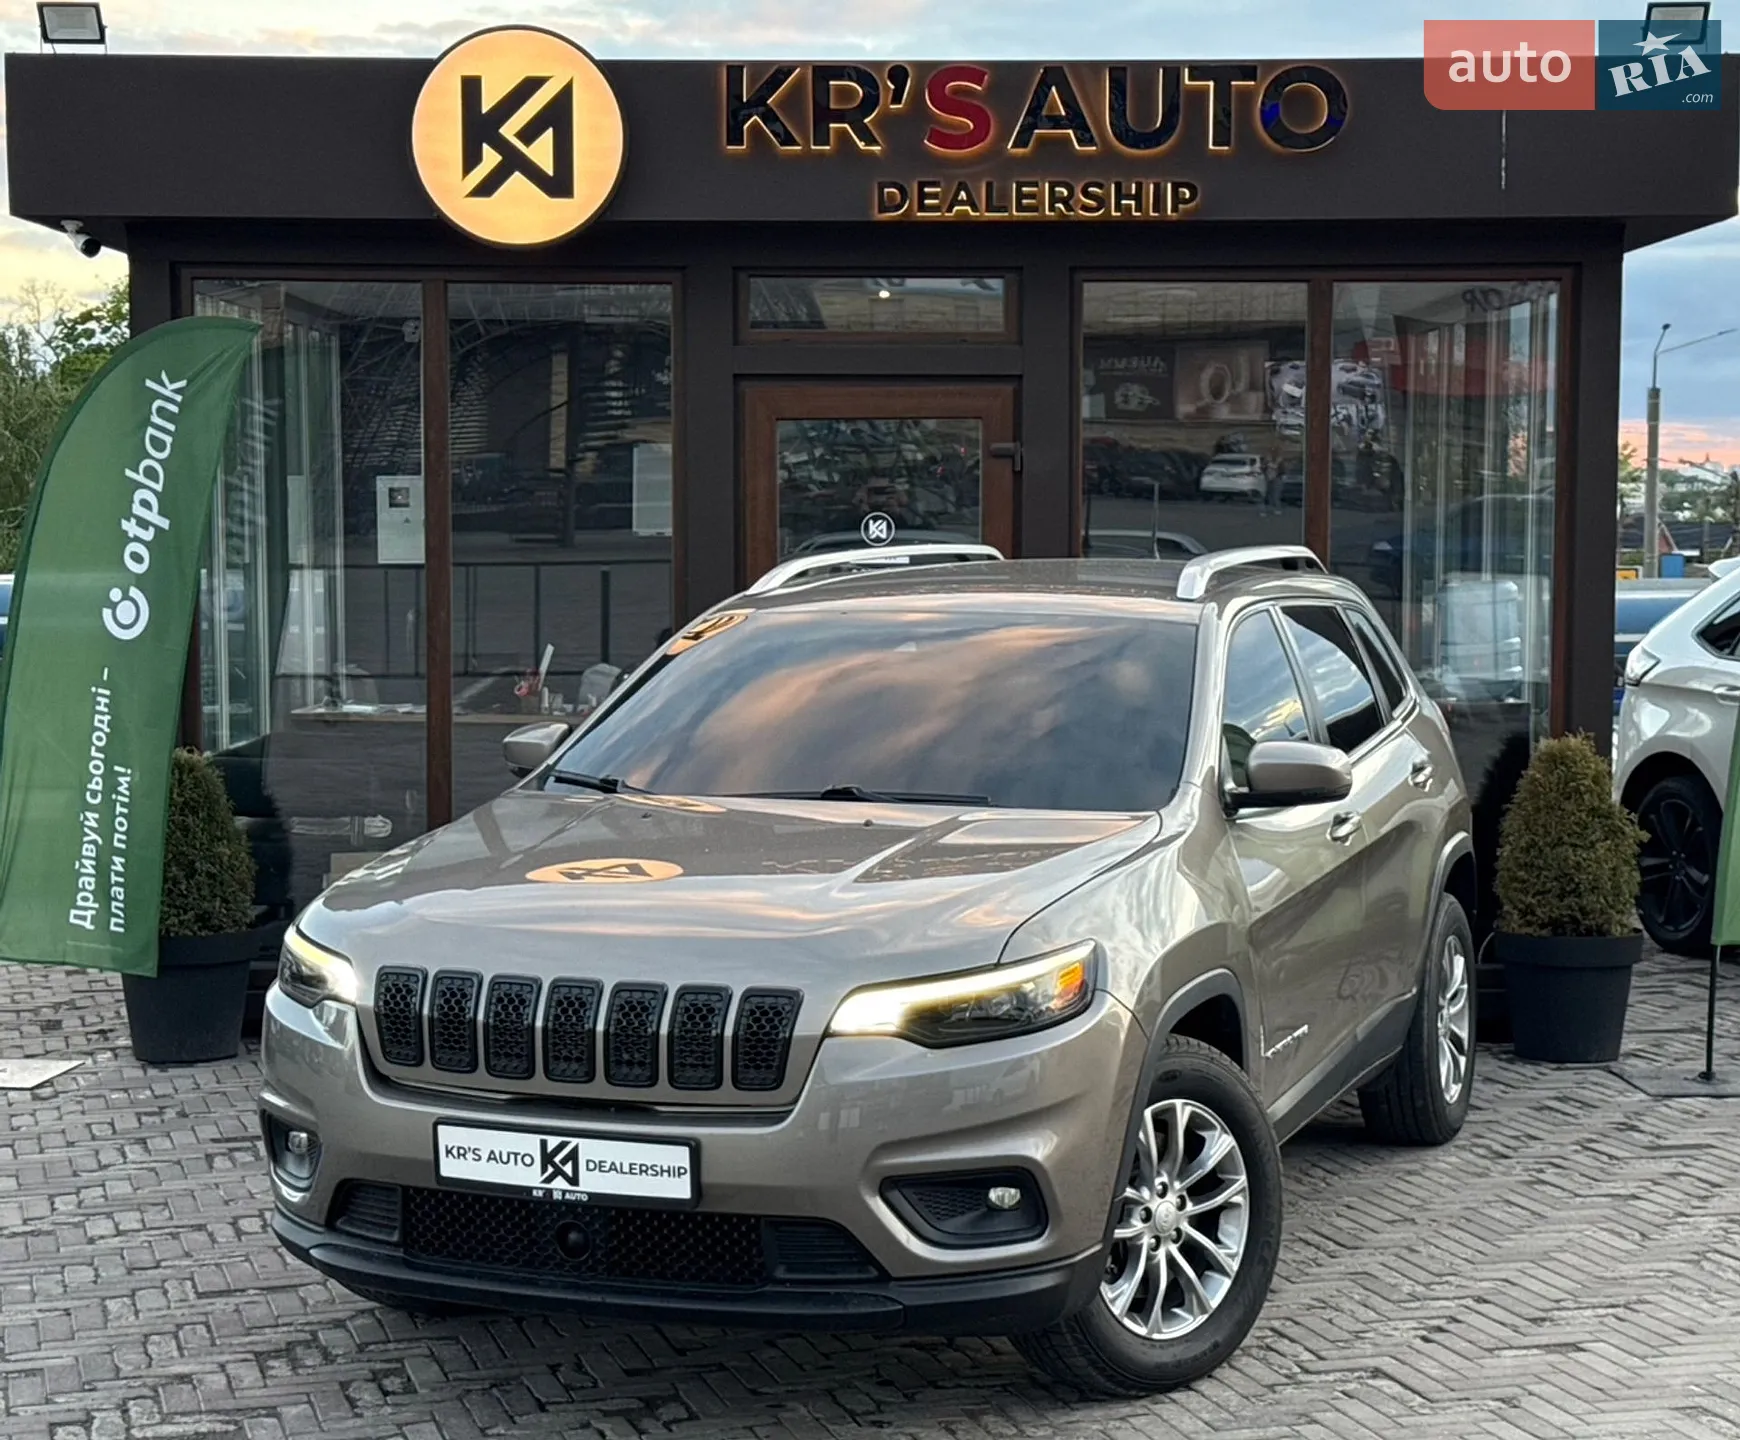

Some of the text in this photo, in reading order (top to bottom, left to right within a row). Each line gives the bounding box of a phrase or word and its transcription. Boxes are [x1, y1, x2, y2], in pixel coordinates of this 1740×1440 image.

[725, 64, 1348, 153] KR'S AUTO
[876, 180, 1200, 216] DEALERSHIP
[121, 370, 187, 574] otpbank
[85, 686, 112, 805] сьогодні
[69, 811, 102, 930] Драйвуй
[110, 765, 132, 933] плати потім!
[444, 1144, 483, 1163] KR'S
[486, 1150, 535, 1168] AUTO
[585, 1159, 689, 1179] DEALERSHIP
[564, 1191, 589, 1202] AUTO
